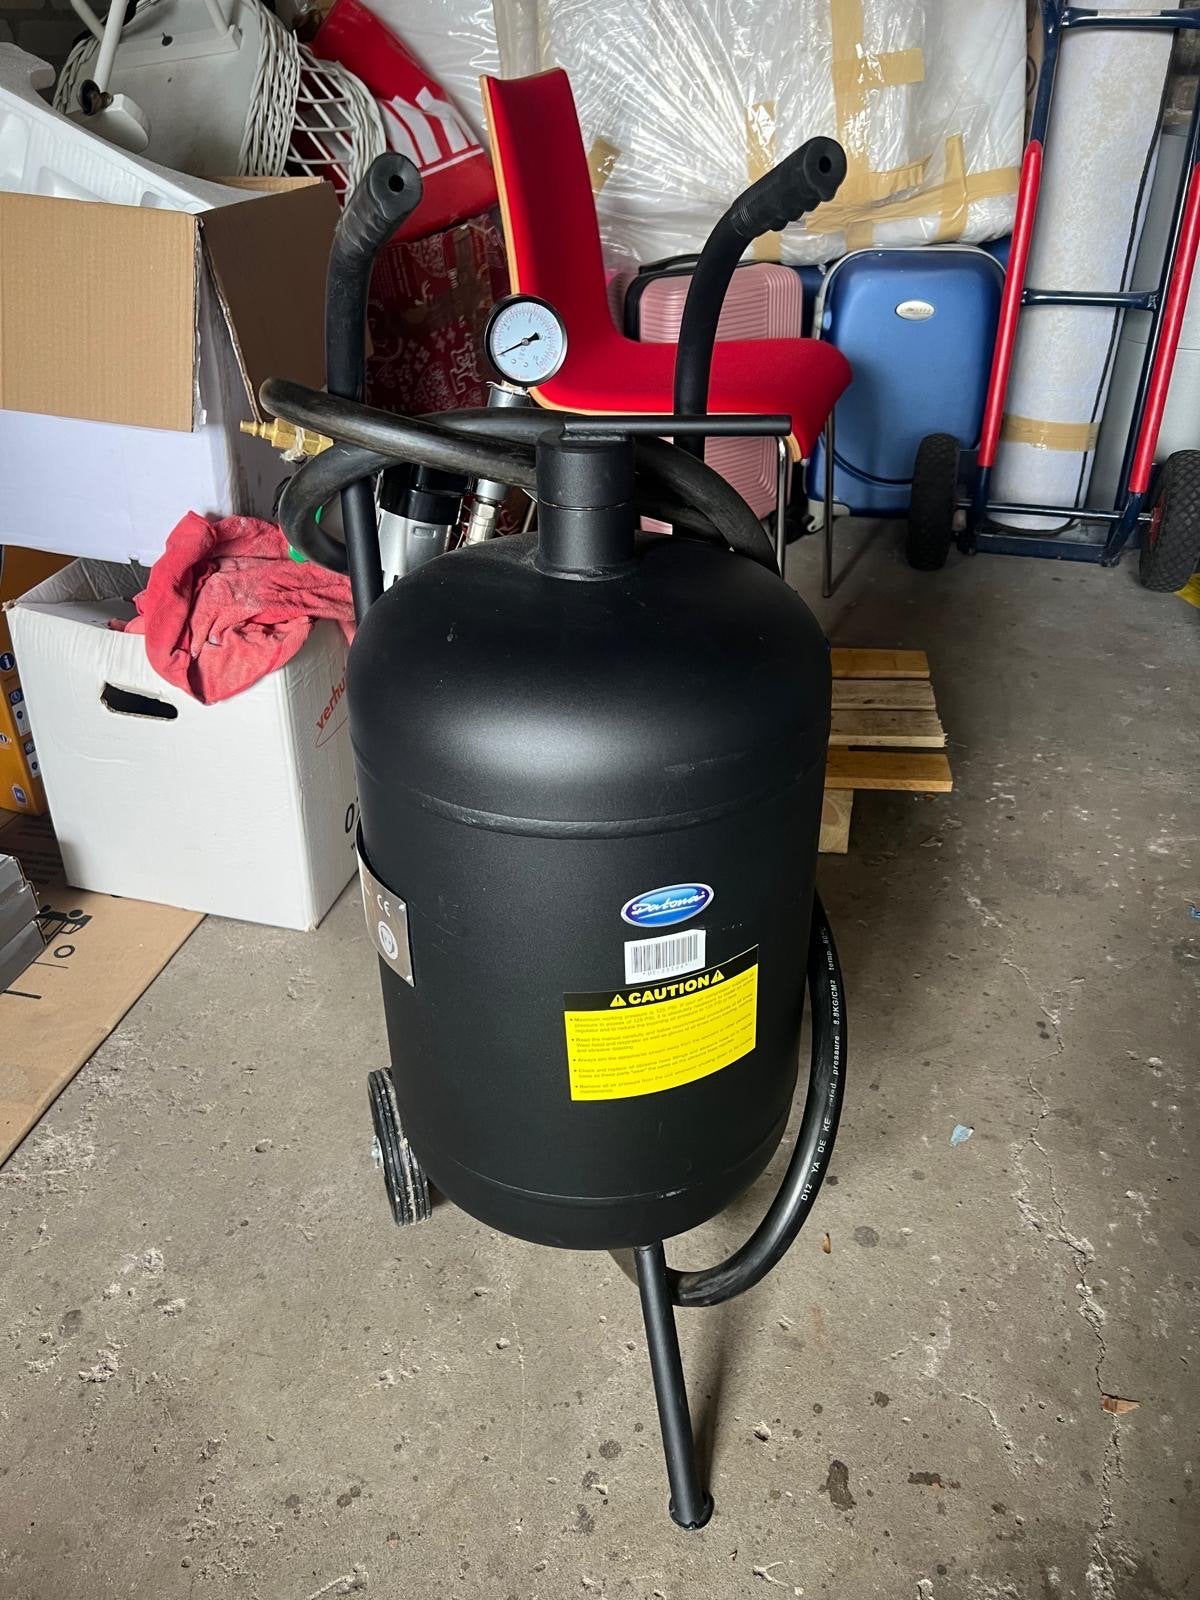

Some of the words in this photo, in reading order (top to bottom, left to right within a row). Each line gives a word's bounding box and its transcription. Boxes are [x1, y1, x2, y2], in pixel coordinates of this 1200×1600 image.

[316, 673, 346, 730] verhu
[628, 974, 710, 1004] CAUTION
[800, 1182, 813, 1202] D12
[811, 1160, 822, 1177] YA
[817, 1139, 827, 1154] DE
[822, 1117, 831, 1133] KE
[833, 1035, 841, 1076] pressure
